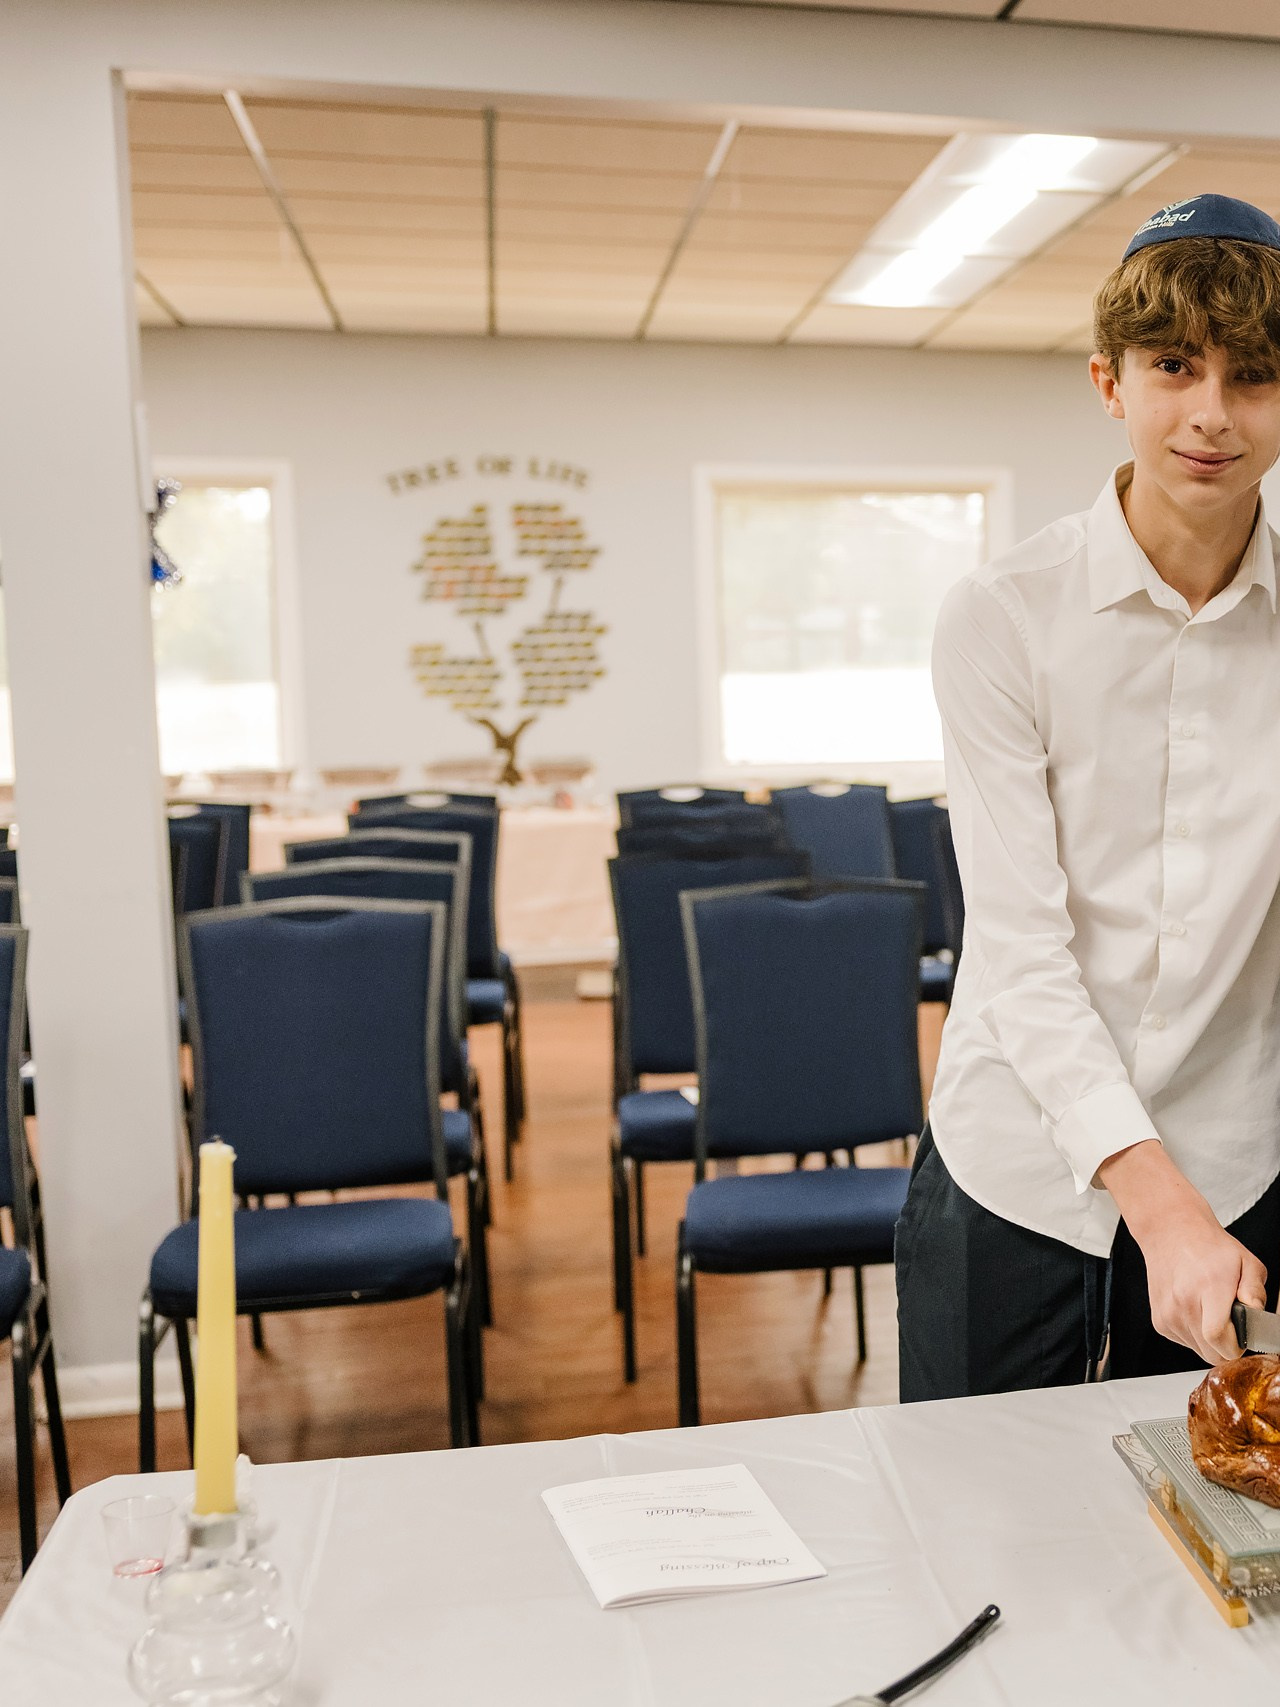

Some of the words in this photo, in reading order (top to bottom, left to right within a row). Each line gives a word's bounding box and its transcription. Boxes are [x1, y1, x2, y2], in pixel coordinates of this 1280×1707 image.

[386, 457, 460, 496] TREE
[475, 454, 513, 475] OF
[528, 455, 590, 490] LIFE
[646, 1507, 706, 1517] Challah
[660, 1562, 730, 1572] Blessing
[736, 1559, 751, 1569] of
[757, 1557, 790, 1567] Cup
